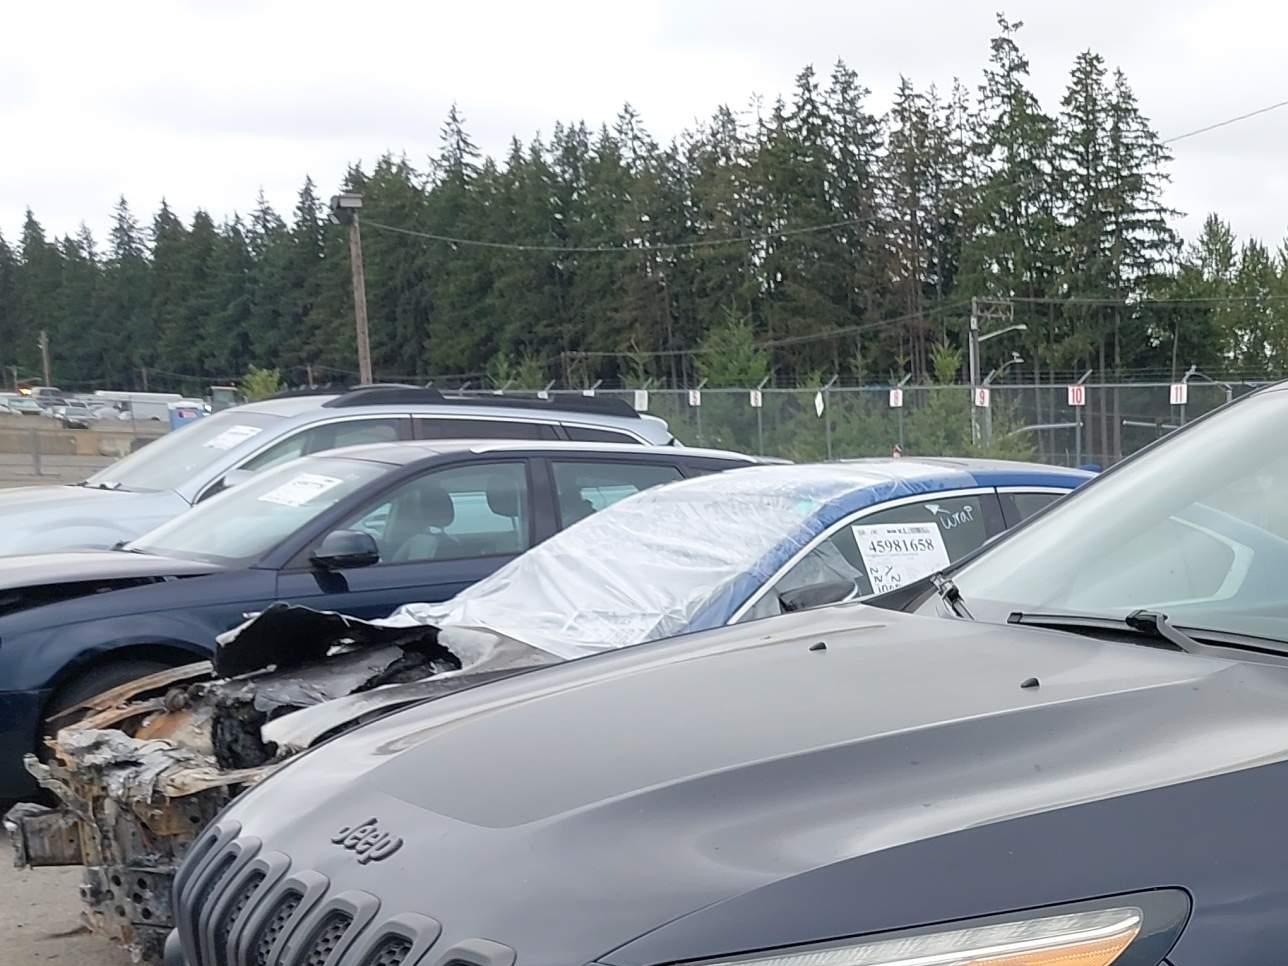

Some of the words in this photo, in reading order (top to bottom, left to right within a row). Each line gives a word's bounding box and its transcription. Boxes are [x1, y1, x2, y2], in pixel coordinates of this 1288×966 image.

[978, 389, 986, 405] 9
[1070, 387, 1083, 404] 10
[1173, 386, 1184, 403] 11
[868, 538, 935, 553] 45981658
[331, 818, 404, 865] Jeep
